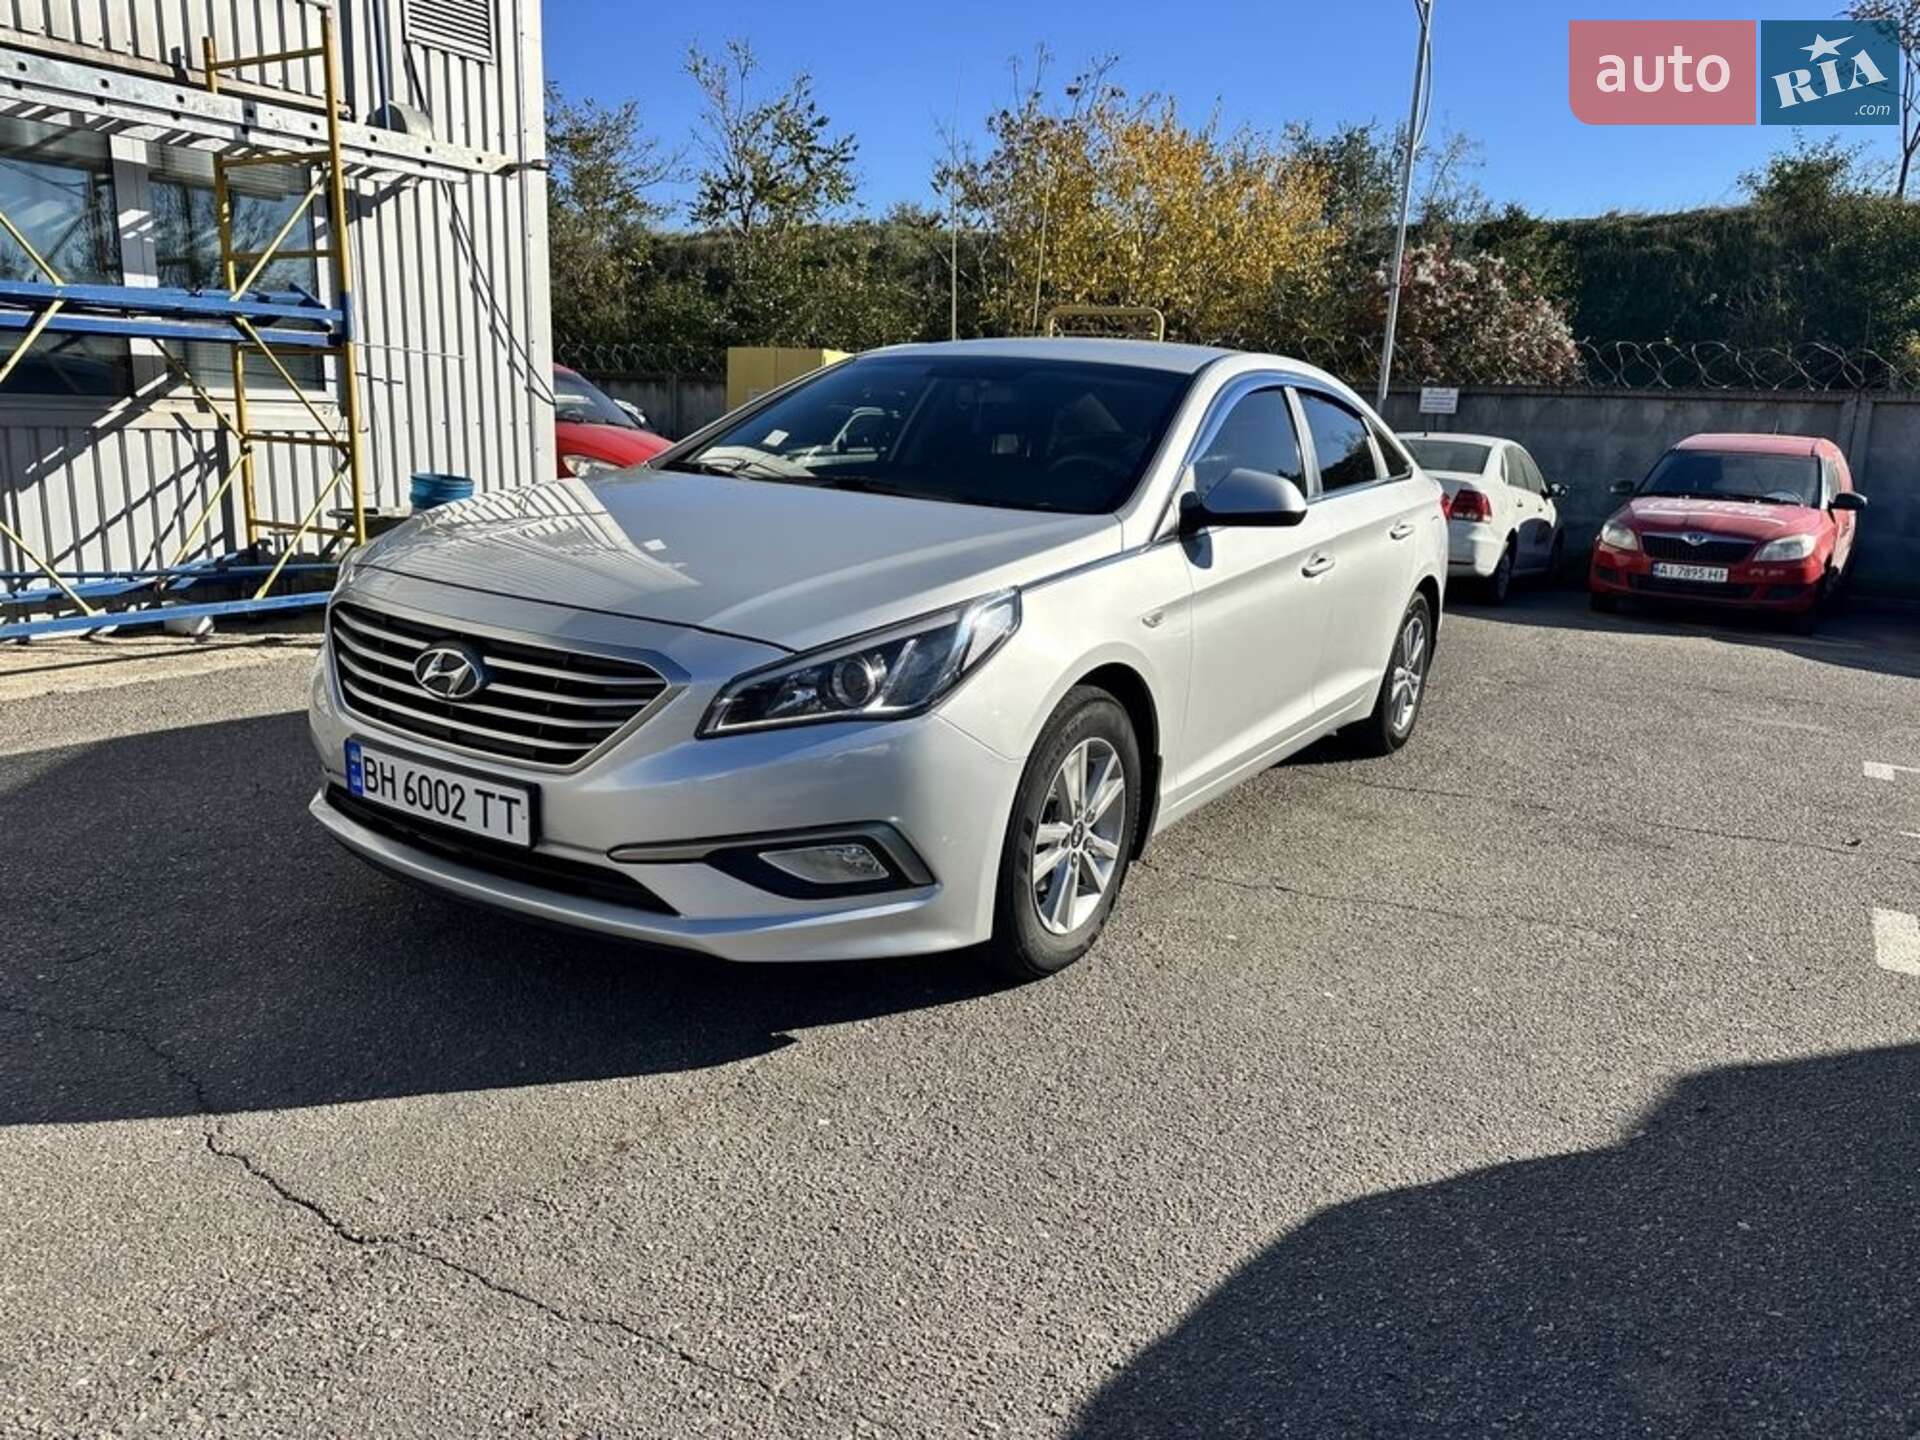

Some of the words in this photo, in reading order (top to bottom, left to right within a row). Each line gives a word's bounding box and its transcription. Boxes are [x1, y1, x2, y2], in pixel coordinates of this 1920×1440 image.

[362, 755, 396, 801] BH
[404, 770, 466, 822] 6002
[475, 788, 521, 835] TT
